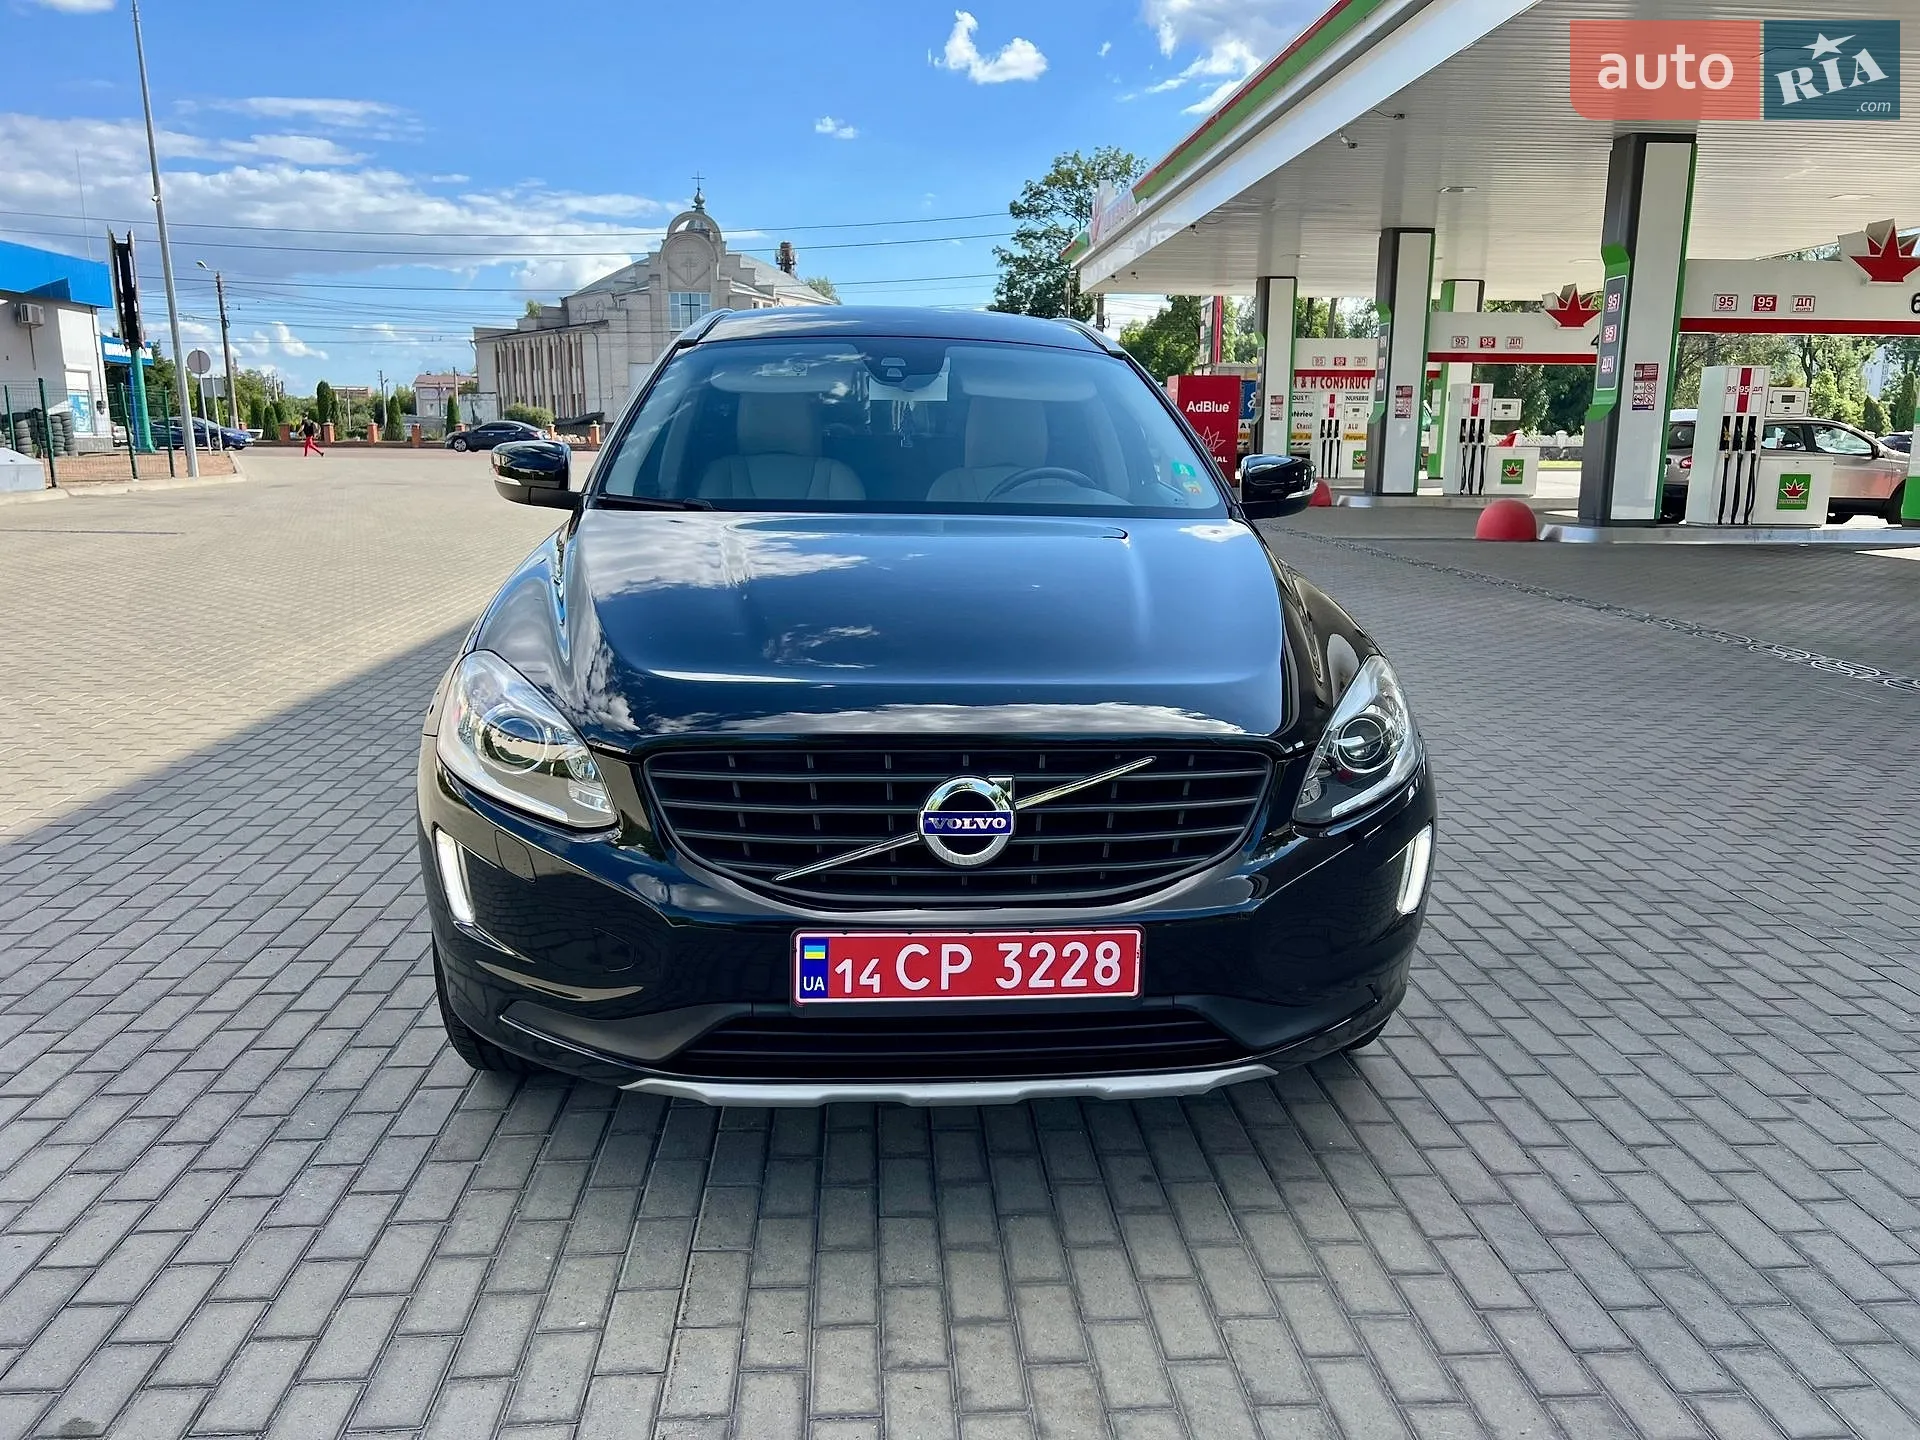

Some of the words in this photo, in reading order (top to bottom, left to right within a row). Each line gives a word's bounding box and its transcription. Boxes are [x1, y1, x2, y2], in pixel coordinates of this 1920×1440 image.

[1719, 296, 1734, 307] 95
[1757, 296, 1773, 307] 95
[1795, 297, 1812, 307] ДП
[1455, 337, 1466, 345] 95
[1482, 337, 1494, 346] 95
[1319, 377, 1370, 390] CONSTRUCT
[928, 817, 1007, 830] VOLVO
[834, 958, 882, 993] 14
[895, 944, 974, 991] CP
[995, 941, 1122, 990] 3228
[803, 976, 826, 992] UA
